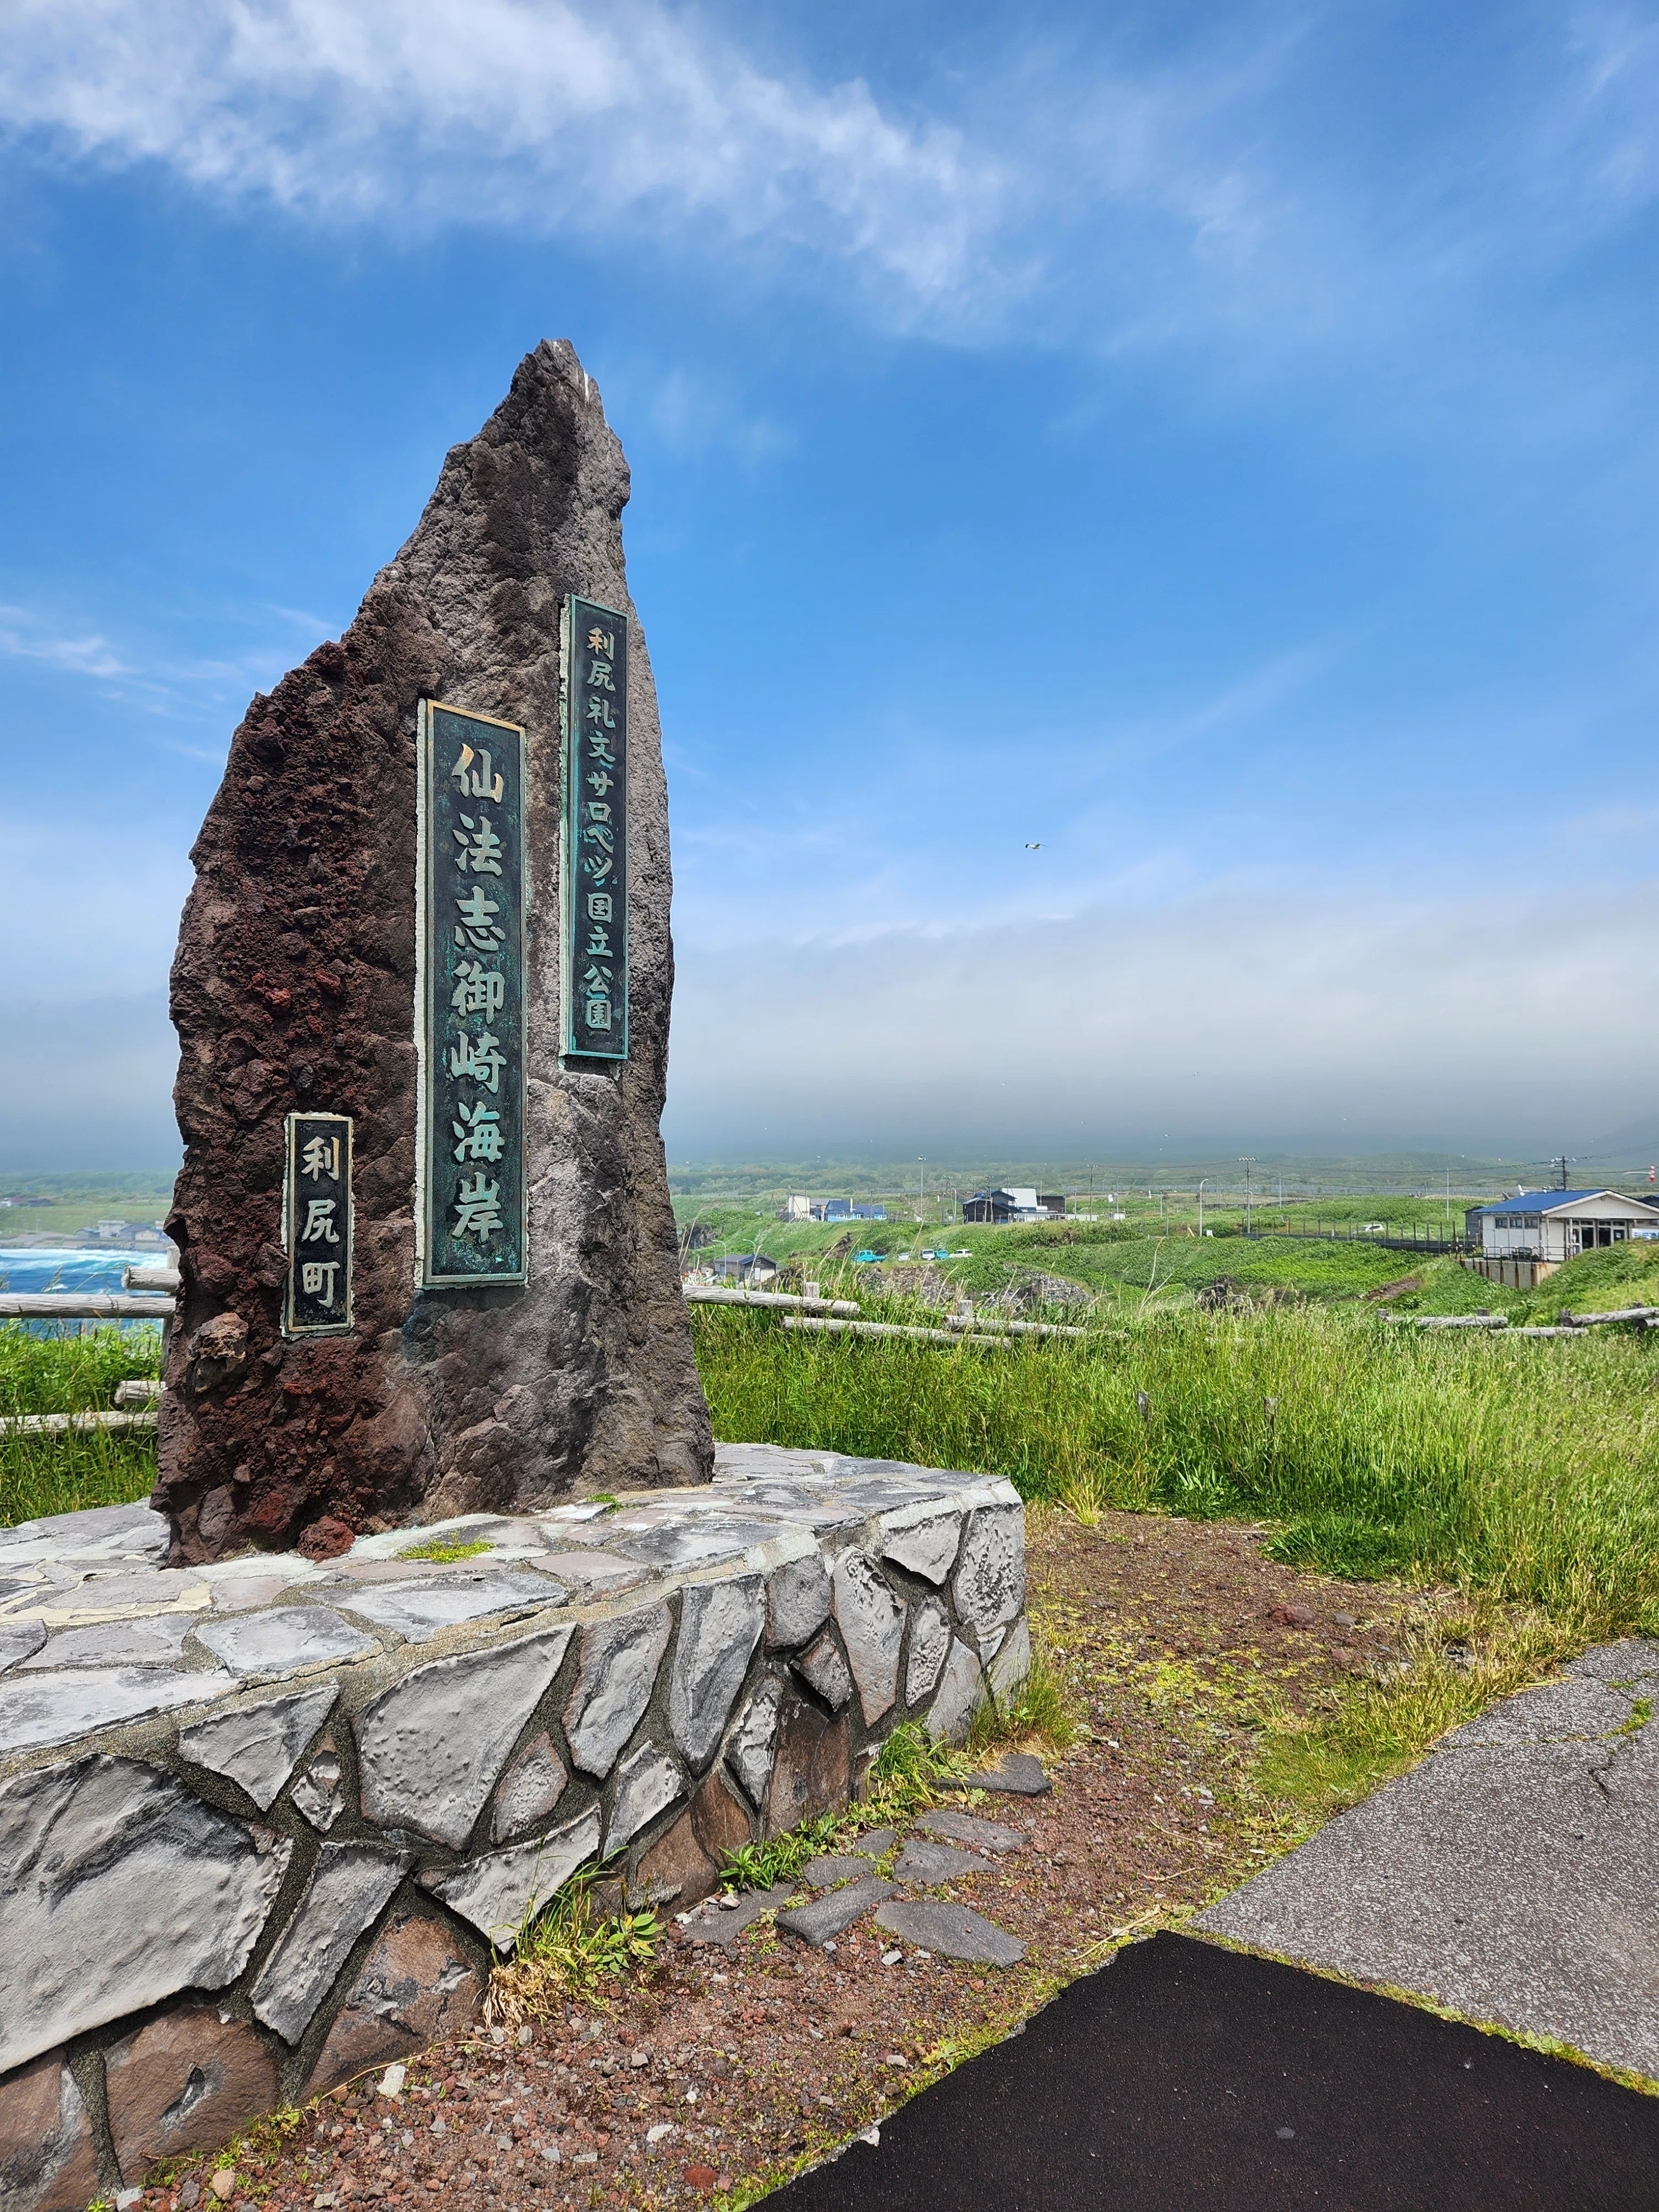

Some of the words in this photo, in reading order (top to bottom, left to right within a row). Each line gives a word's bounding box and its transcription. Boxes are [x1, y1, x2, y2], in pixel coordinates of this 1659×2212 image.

[450, 742, 507, 1242] 仙法志御崎海岸
[583, 627, 615, 1031] 利尻礼文サロベツ国立公園
[301, 1135, 341, 1308] 利尻町
